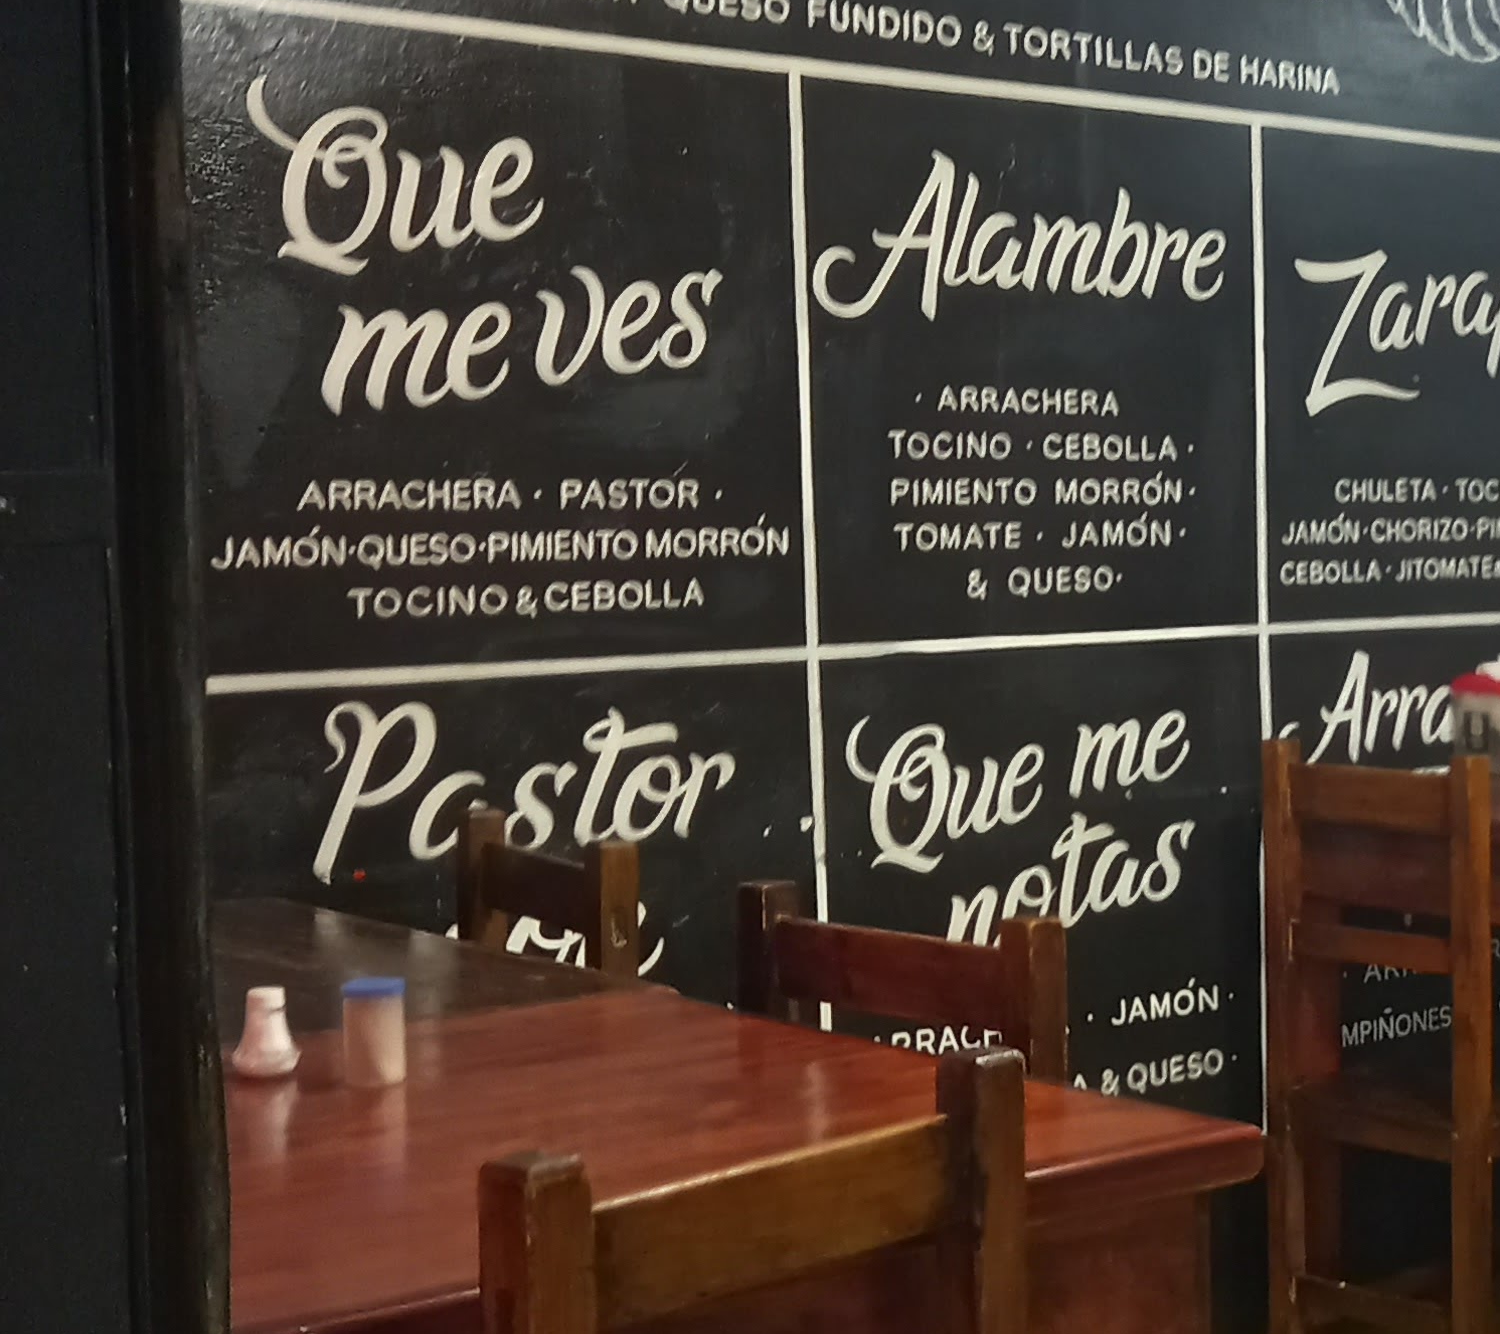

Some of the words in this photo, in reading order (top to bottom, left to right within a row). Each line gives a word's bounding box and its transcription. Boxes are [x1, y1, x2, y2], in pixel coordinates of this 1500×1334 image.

[972, 20, 996, 55] &
[1002, 22, 1185, 77] TORTILLAS
[1192, 48, 1231, 83] DE
[1239, 55, 1341, 96] HARINA
[246, 73, 544, 276] Que
[812, 149, 1227, 322] Alambre
[321, 302, 512, 415] me
[534, 265, 723, 386] ves
[936, 384, 1120, 418] ARRACHERA
[888, 428, 1013, 462] TOCINO
[1041, 432, 1178, 462] CEBOLLA
[296, 477, 522, 512] ARRACHERA
[559, 478, 700, 511] PASTOR
[889, 477, 1038, 508] PIMIENTO
[1054, 470, 1183, 507] MORRÓN
[1333, 477, 1437, 504] CHULETA
[644, 513, 790, 559] MORRÓN
[892, 521, 1022, 552] TOMATE
[1061, 510, 1172, 549] JAMÓN
[966, 567, 989, 601] &
[1007, 564, 1115, 599] QUESO
[1279, 558, 1382, 586] CEBOLLA
[346, 584, 509, 619] TOCINO
[514, 586, 539, 619] &
[543, 576, 706, 613] CEBOLLA
[844, 714, 1047, 876] Que
[1068, 709, 1191, 799] me
[1110, 977, 1220, 1027] JAMÓN
[1100, 1068, 1121, 1098] &
[1126, 1047, 1225, 1095] QUESO
